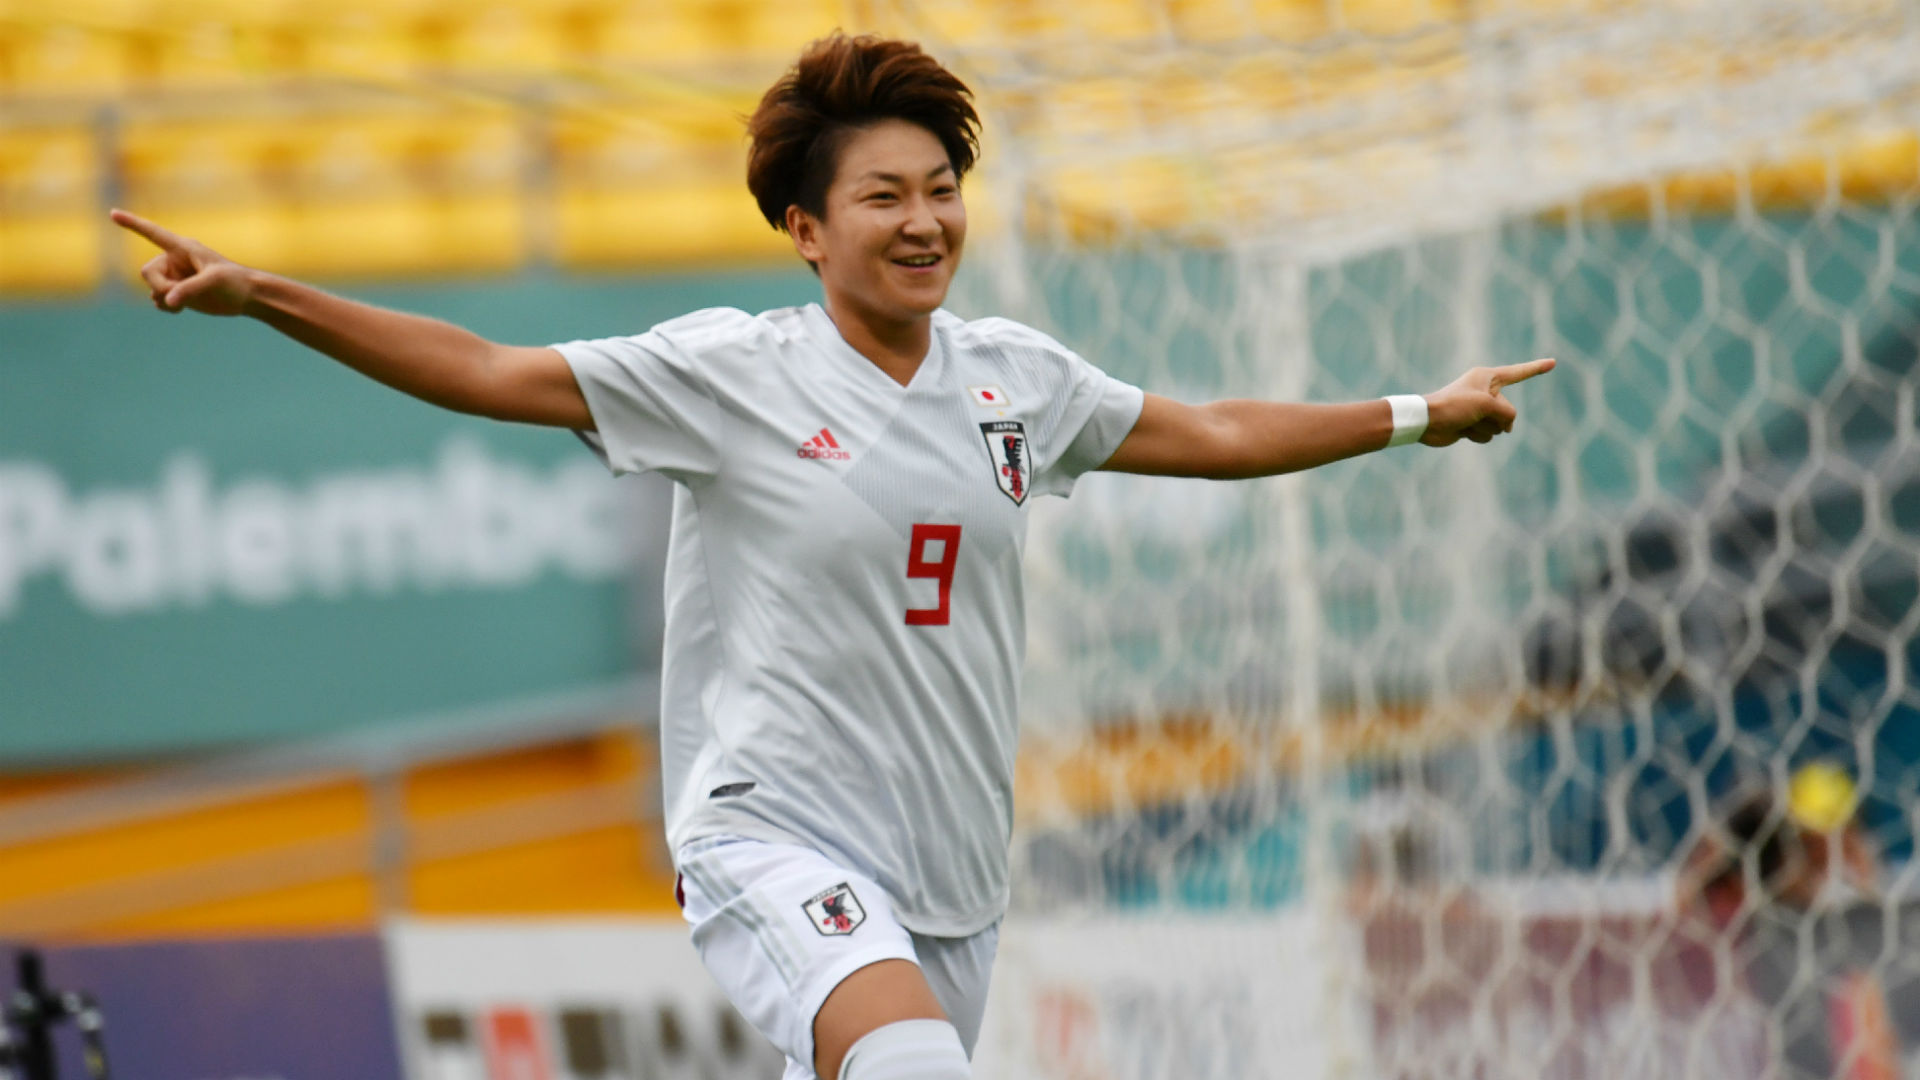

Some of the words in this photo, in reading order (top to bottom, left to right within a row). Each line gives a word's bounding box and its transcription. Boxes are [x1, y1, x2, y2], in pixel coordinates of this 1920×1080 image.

[992, 422, 1018, 431] JAPAN
[797, 447, 851, 461] adidas
[905, 523, 962, 626] 9
